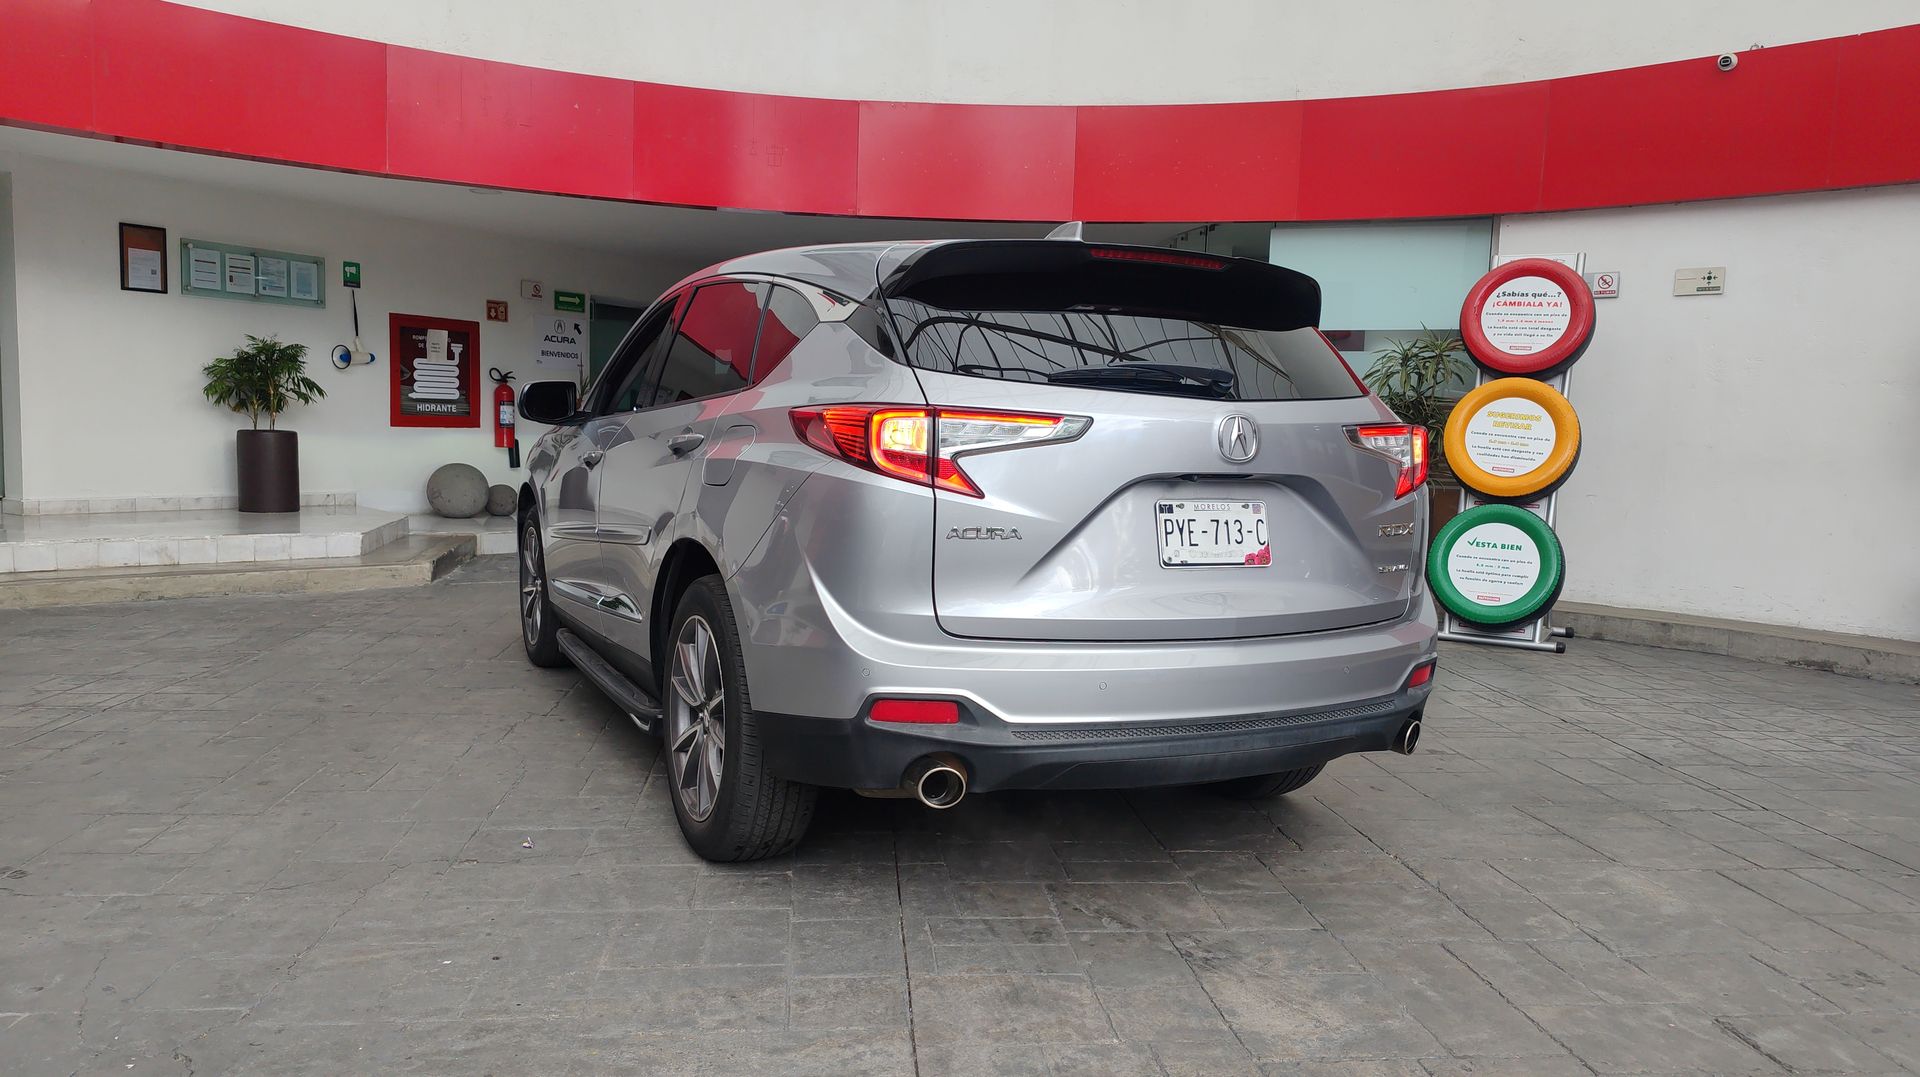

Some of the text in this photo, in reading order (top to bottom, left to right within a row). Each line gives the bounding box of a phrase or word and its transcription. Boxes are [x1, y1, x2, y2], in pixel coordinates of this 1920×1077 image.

[544, 335, 577, 344] ACURA
[541, 350, 578, 359] BIENVENIDOS
[416, 404, 457, 412] HIDRANTE
[946, 526, 1022, 540] ACURA
[1164, 519, 1266, 547] PYE-713-C
[1378, 522, 1414, 537] RDX
[1476, 541, 1497, 549] ESTA
